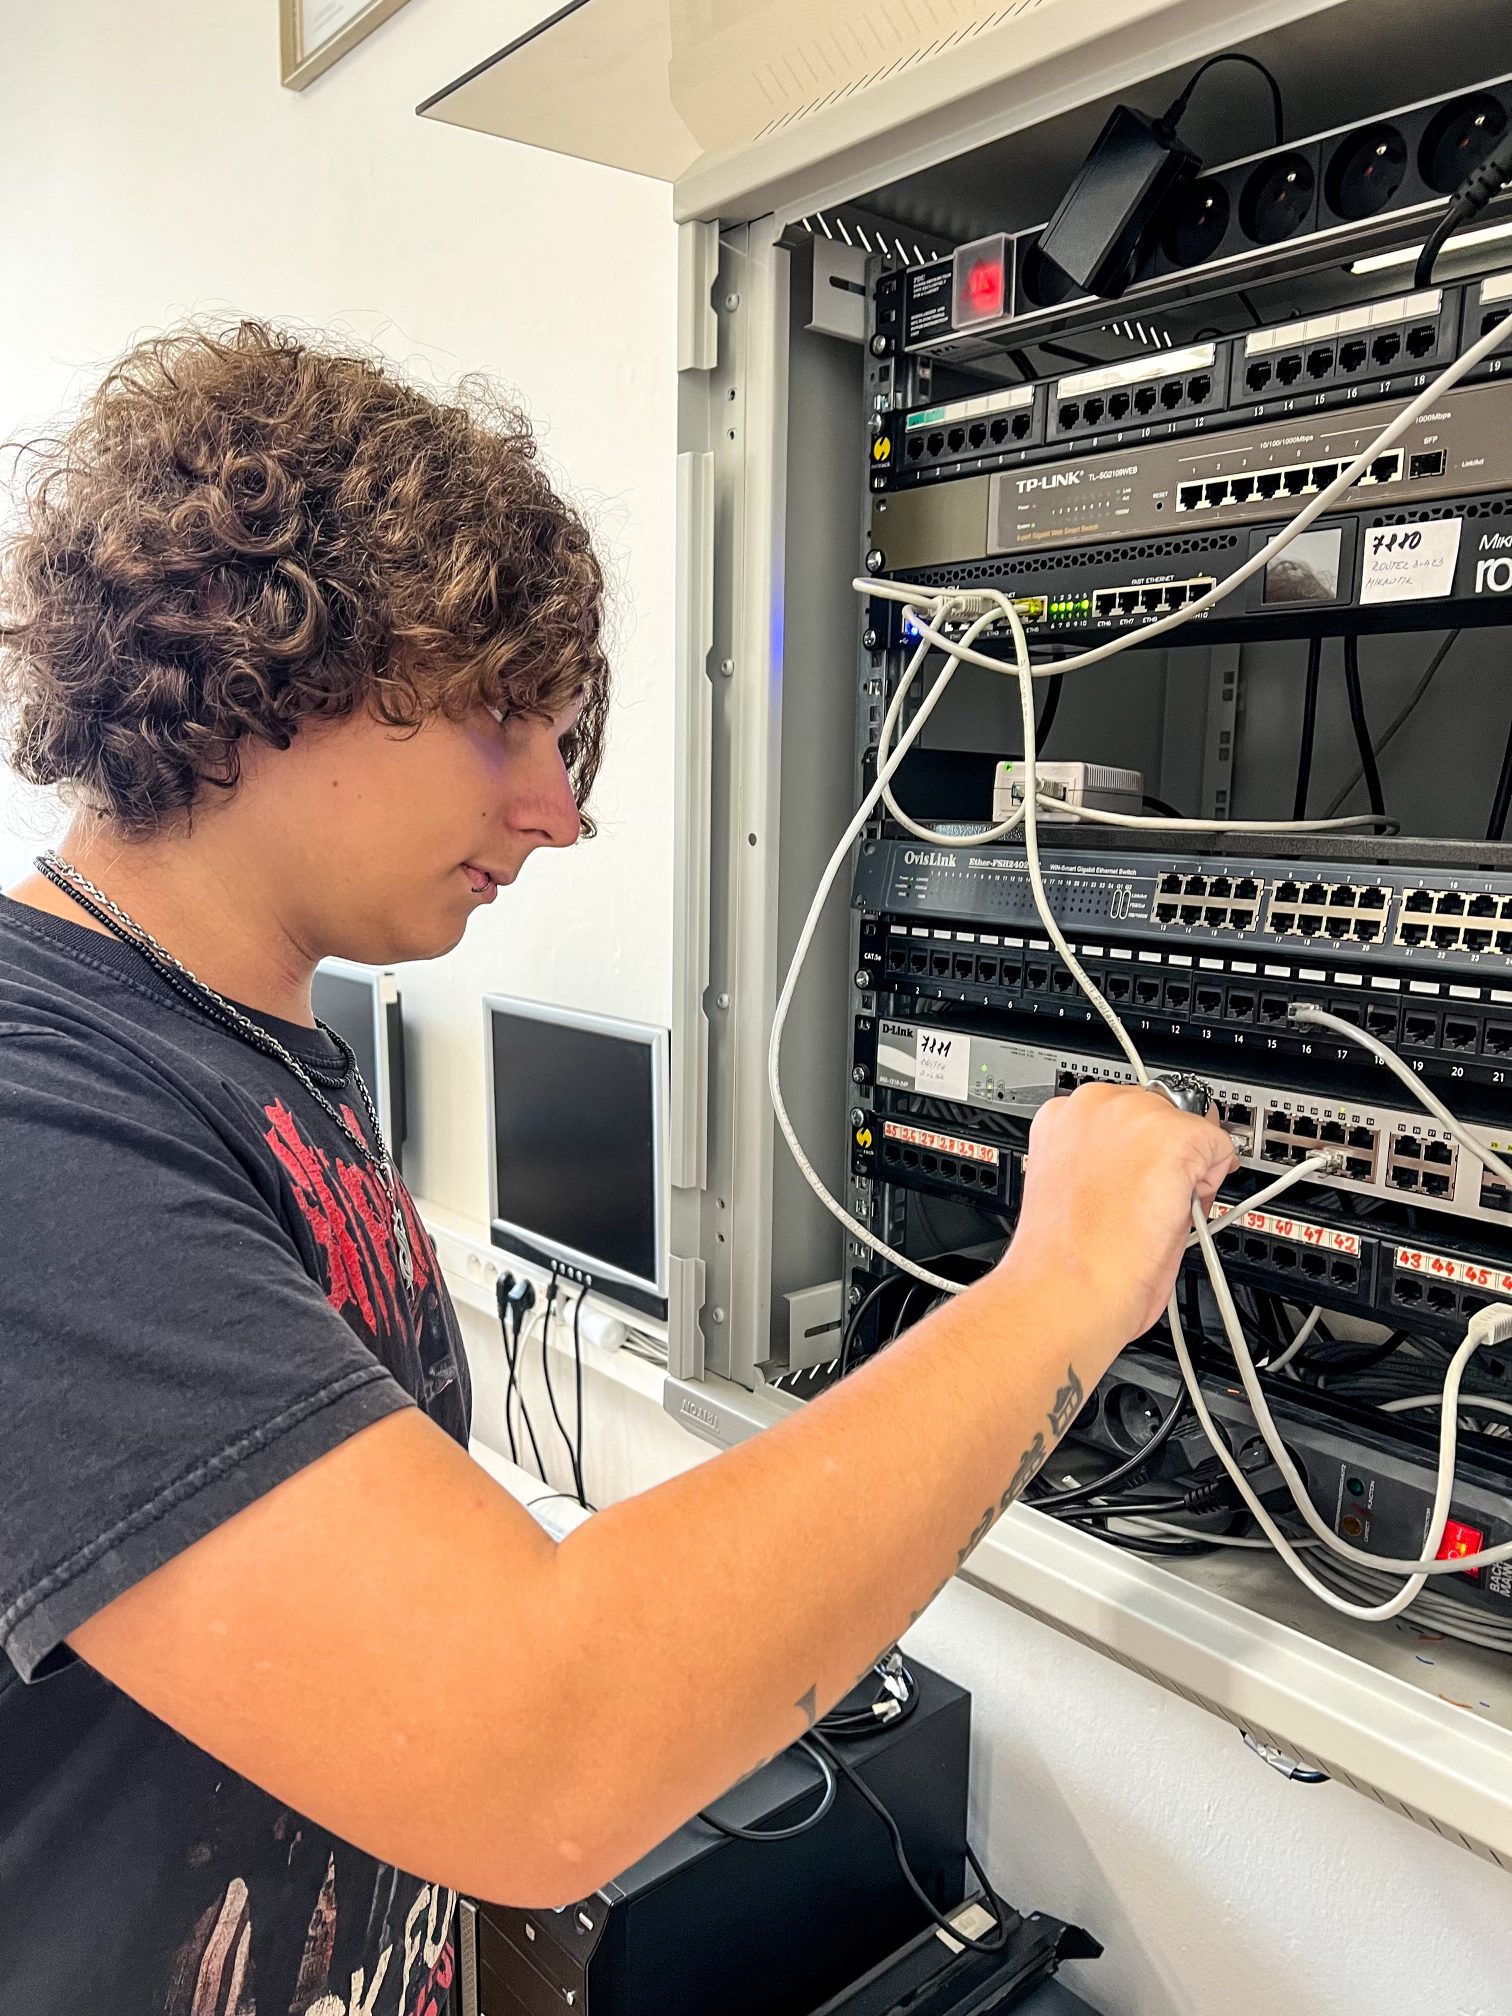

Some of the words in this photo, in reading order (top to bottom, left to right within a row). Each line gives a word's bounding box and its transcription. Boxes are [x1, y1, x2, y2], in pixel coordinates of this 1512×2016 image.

[1117, 432, 1123, 442] 9
[1141, 428, 1151, 438] 10
[1167, 423, 1177, 433] 11
[1194, 417, 1205, 428] 12
[1253, 406, 1264, 417] 13
[1283, 400, 1294, 411] 14
[1314, 394, 1325, 406] 15
[1346, 388, 1358, 399] 16
[1379, 381, 1391, 393] 17
[1414, 375, 1426, 387] 18
[1489, 360, 1502, 372] 19
[1016, 471, 1081, 494] TP-LINK
[904, 850, 957, 868] OvisLink
[1450, 881, 1458, 889] 10
[1362, 944, 1370, 952] 20
[1471, 955, 1480, 963] 23
[882, 1024, 914, 1038] D-Link
[915, 986, 920, 995] 2
[937, 990, 942, 998] 3
[959, 992, 965, 1001] 4
[983, 996, 989, 1005] 5
[1007, 1000, 1013, 1009] 6
[1032, 1004, 1038, 1012] 7
[1059, 1008, 1065, 1017] 8
[1086, 1012, 1092, 1021] 9
[1141, 1020, 1150, 1030] 11
[1171, 1025, 1180, 1034] 12
[1202, 1029, 1211, 1039] 13
[1234, 1035, 1244, 1044] 14
[1267, 1039, 1277, 1049] 15
[1302, 1044, 1312, 1054] 16
[1337, 1049, 1348, 1060] 17
[1412, 1061, 1424, 1072] 19
[1451, 1067, 1464, 1077] 20
[1492, 1072, 1505, 1083] 21
[921, 1133, 935, 1145] 27
[940, 1137, 955, 1151] 28
[1247, 1212, 1265, 1229] 39
[1275, 1220, 1293, 1236] 40
[1304, 1226, 1324, 1245] 41
[1334, 1233, 1356, 1254] 42
[1400, 1250, 1422, 1269] 43
[1432, 1257, 1455, 1277] 44
[1465, 1266, 1492, 1285] 45
[1502, 1275, 1512, 1290] 4
